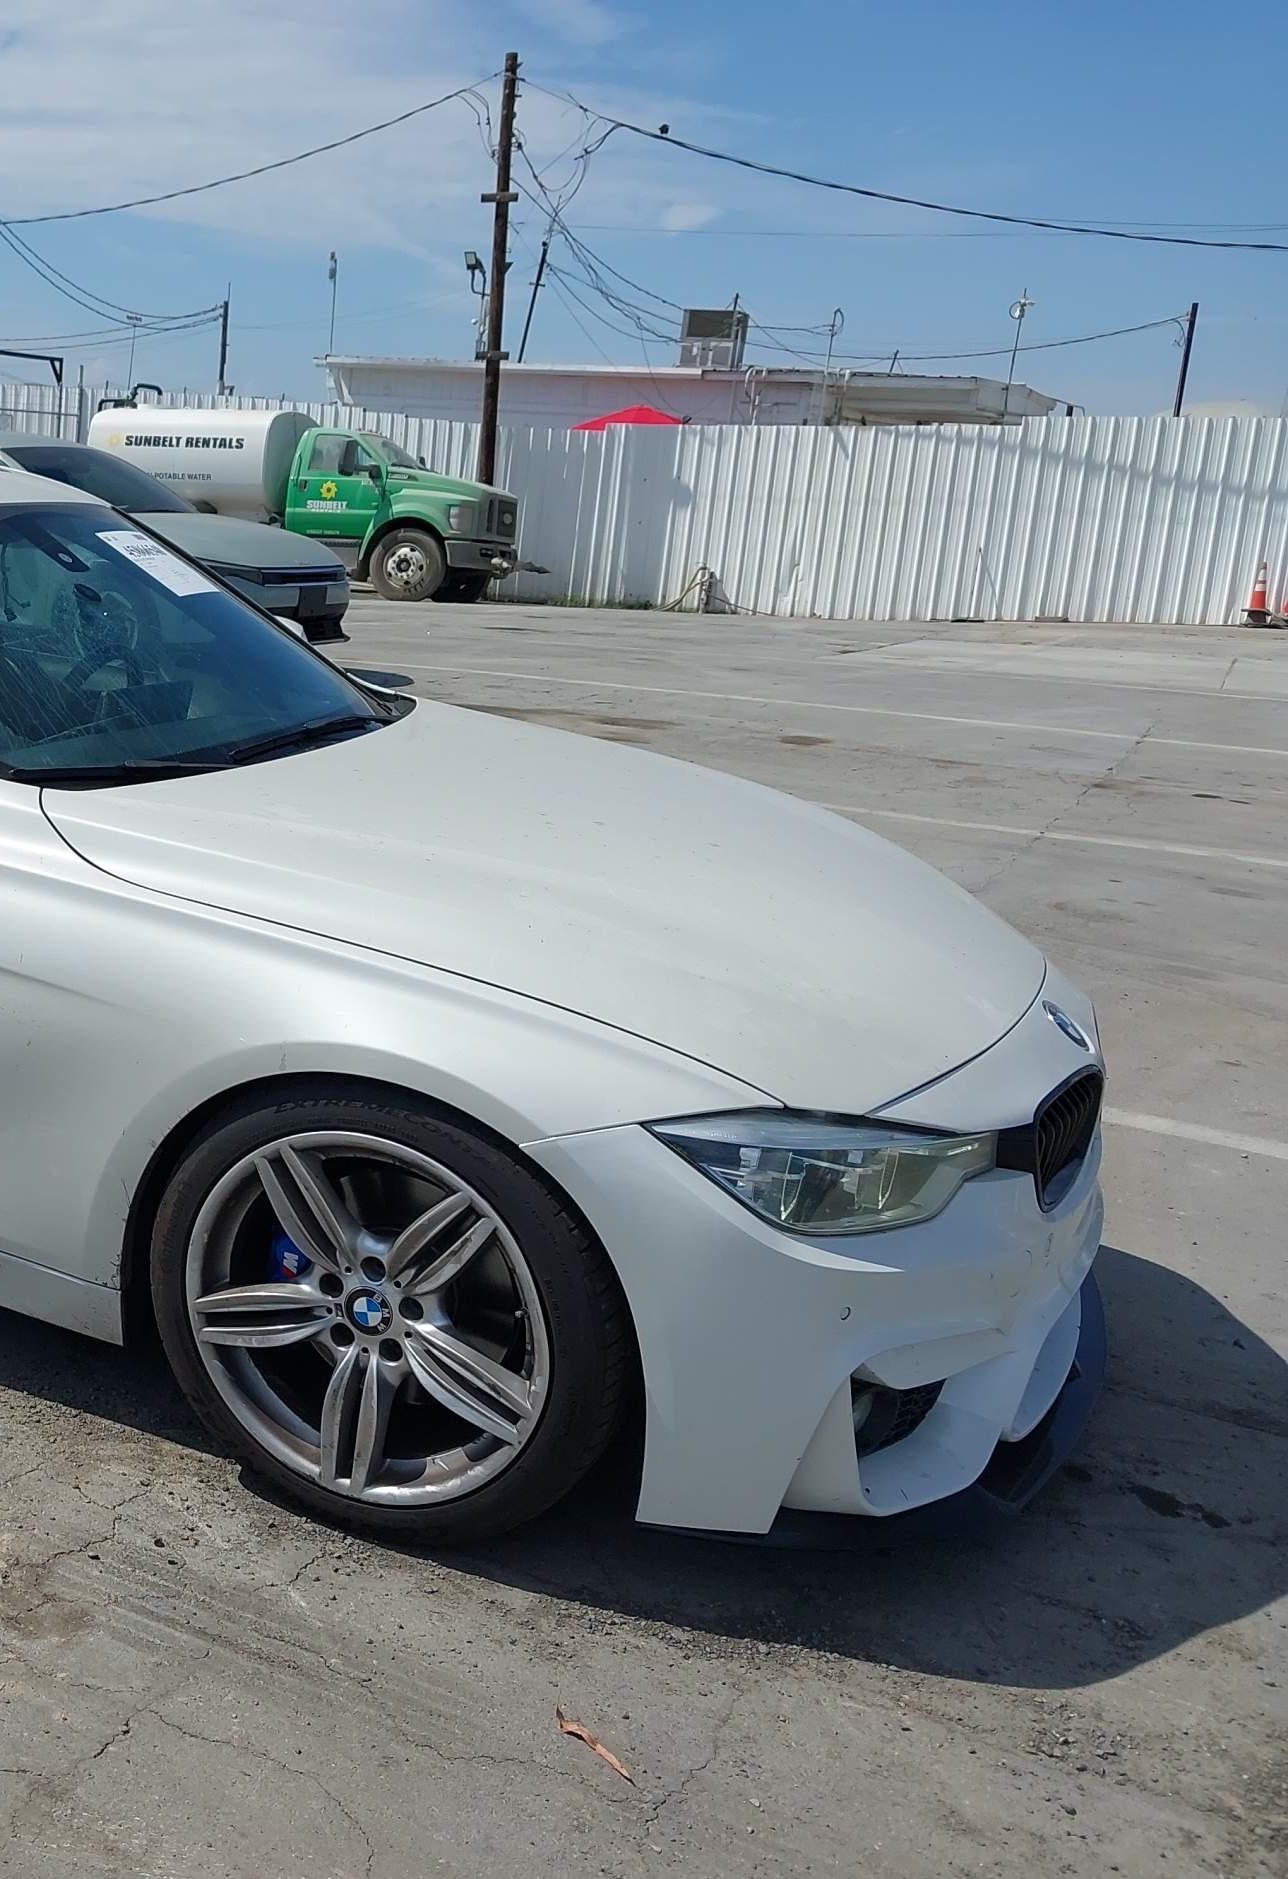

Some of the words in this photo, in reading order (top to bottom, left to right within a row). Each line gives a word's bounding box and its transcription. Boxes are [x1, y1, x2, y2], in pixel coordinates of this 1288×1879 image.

[124, 435, 182, 448] SUNBELT
[185, 436, 245, 449] RENTALS
[187, 473, 212, 481] WATER
[306, 500, 348, 511] SUNBELT
